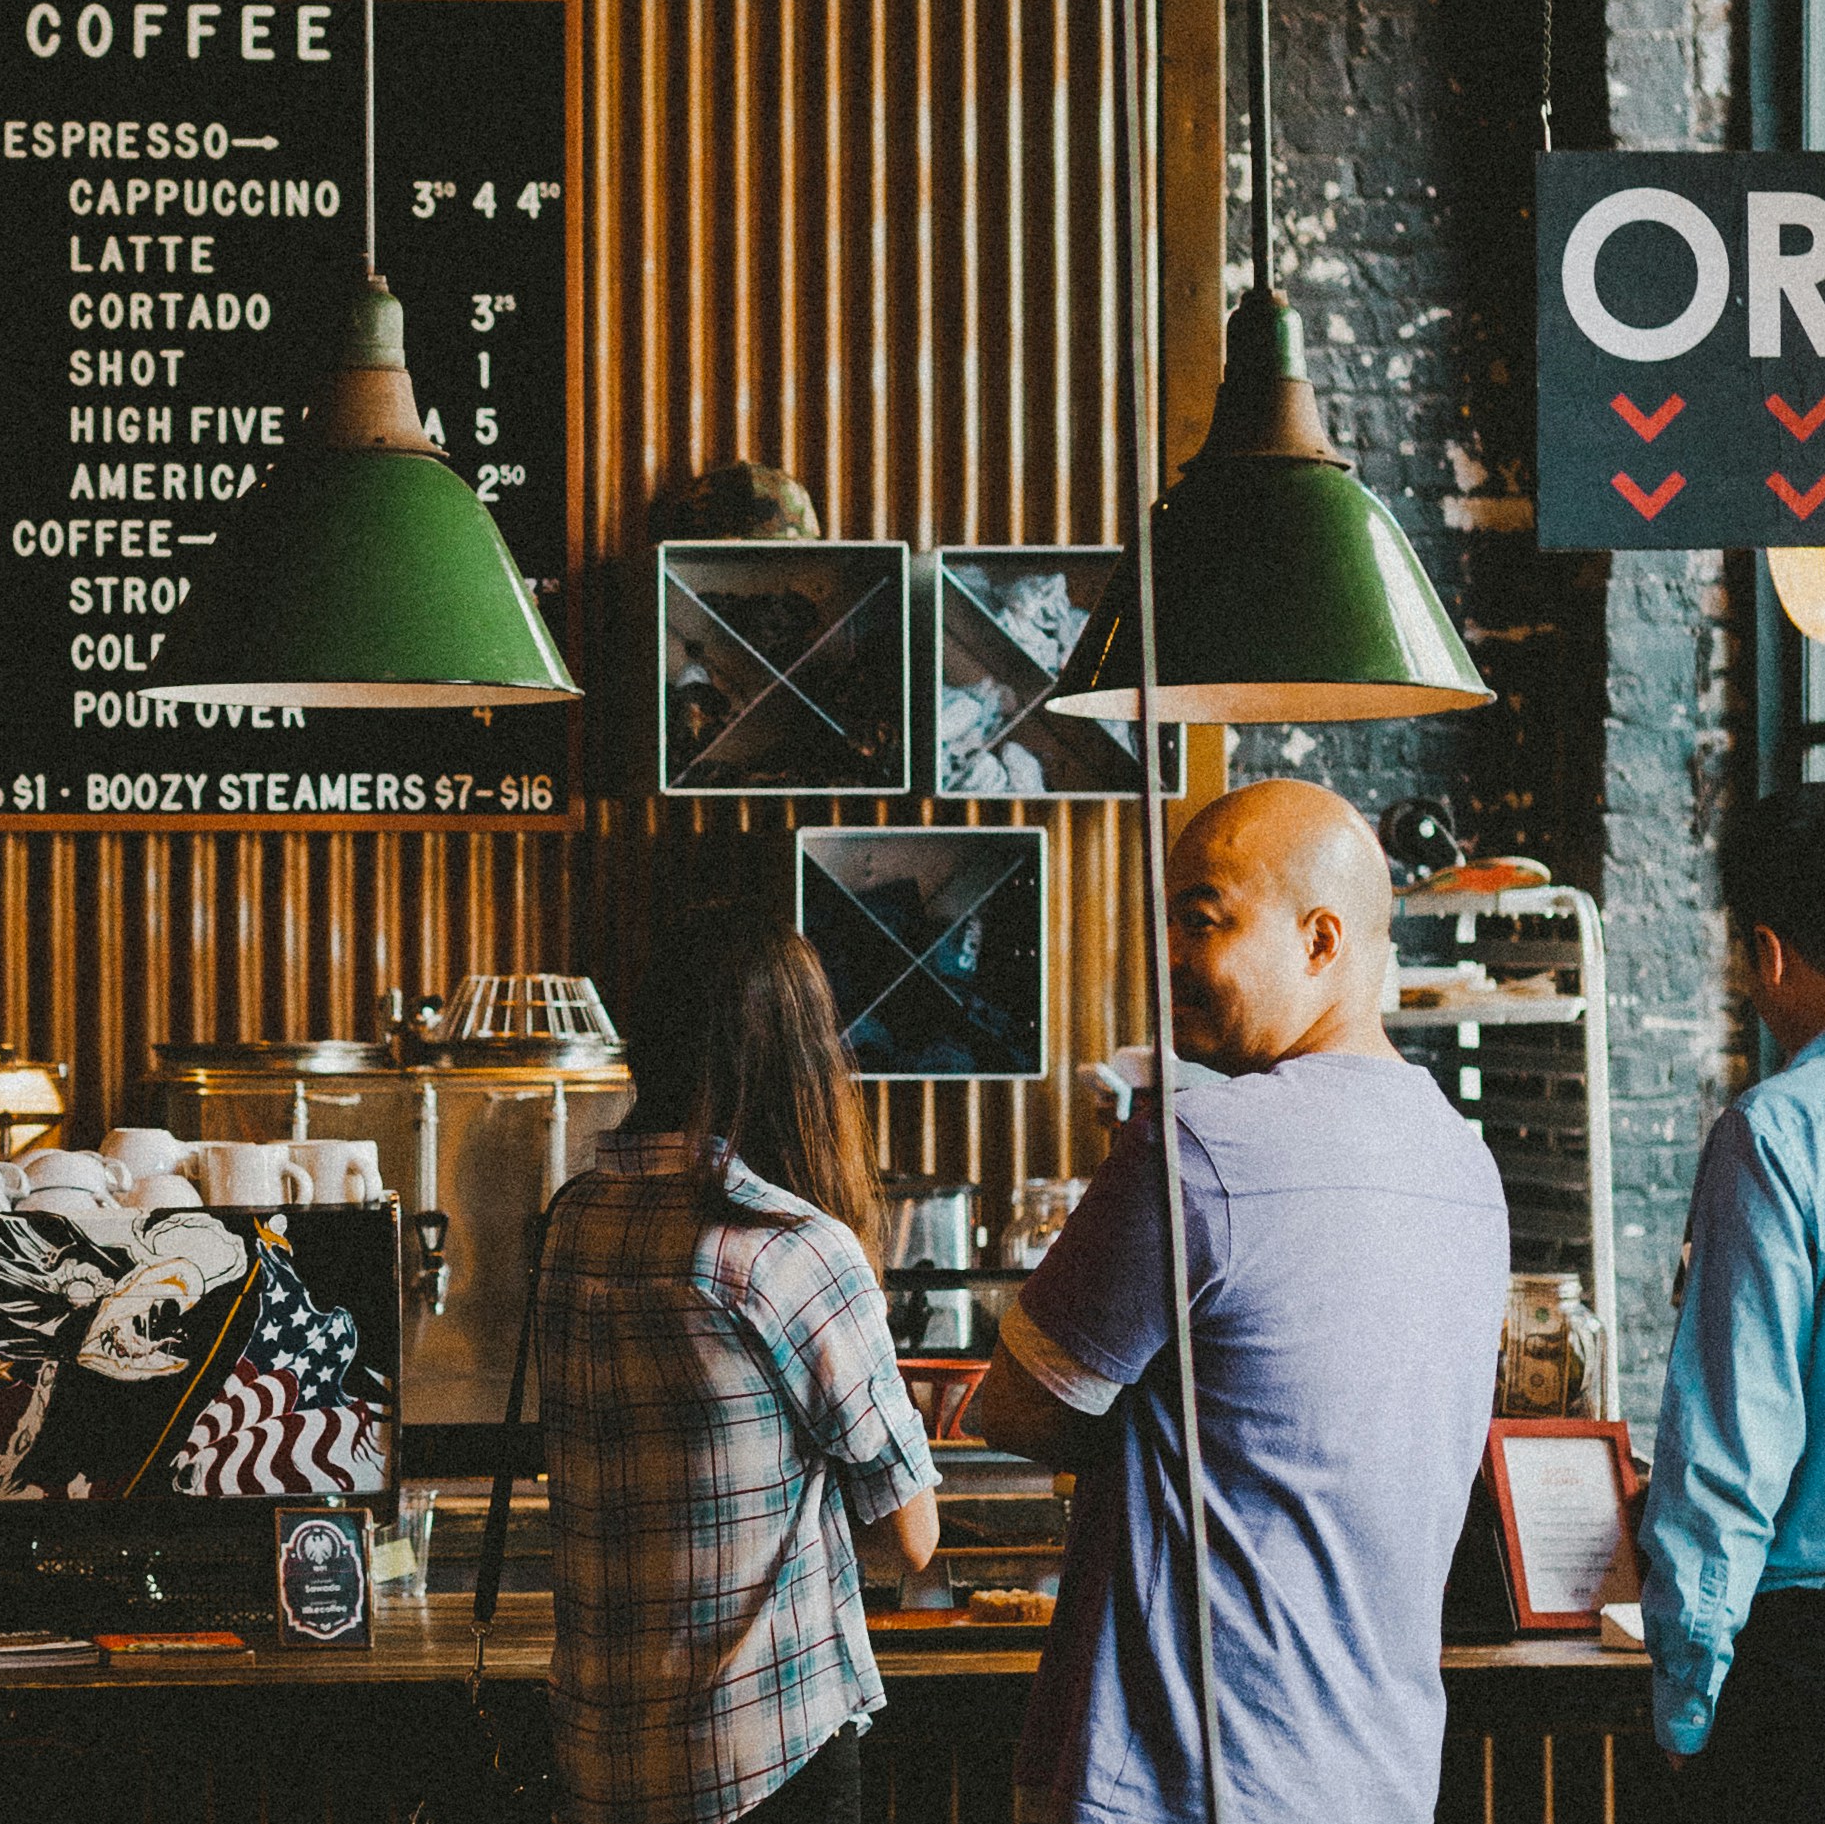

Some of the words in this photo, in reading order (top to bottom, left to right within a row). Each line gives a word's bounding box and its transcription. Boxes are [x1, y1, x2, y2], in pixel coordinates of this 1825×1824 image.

[26, 3, 331, 61] COFFEE
[4, 120, 229, 160] ESPRESSO
[69, 178, 340, 217] CAPPUCCINO
[472, 181, 497, 219] 4
[70, 235, 215, 274] LATTE
[1561, 187, 1825, 362] OR
[69, 292, 271, 331] CORTADO
[69, 349, 185, 387] SHOT
[478, 351, 490, 389] 1
[70, 406, 172, 444] HIGH
[191, 406, 284, 445] FIVE
[475, 407, 499, 445] 5
[69, 462, 257, 501] AMERICA
[12, 519, 172, 558] COFFEE
[69, 576, 191, 615] STRO
[74, 691, 183, 728] POUR
[13, 774, 46, 811] $1
[87, 773, 208, 811] BOOZY
[218, 773, 426, 812] STEAMERS
